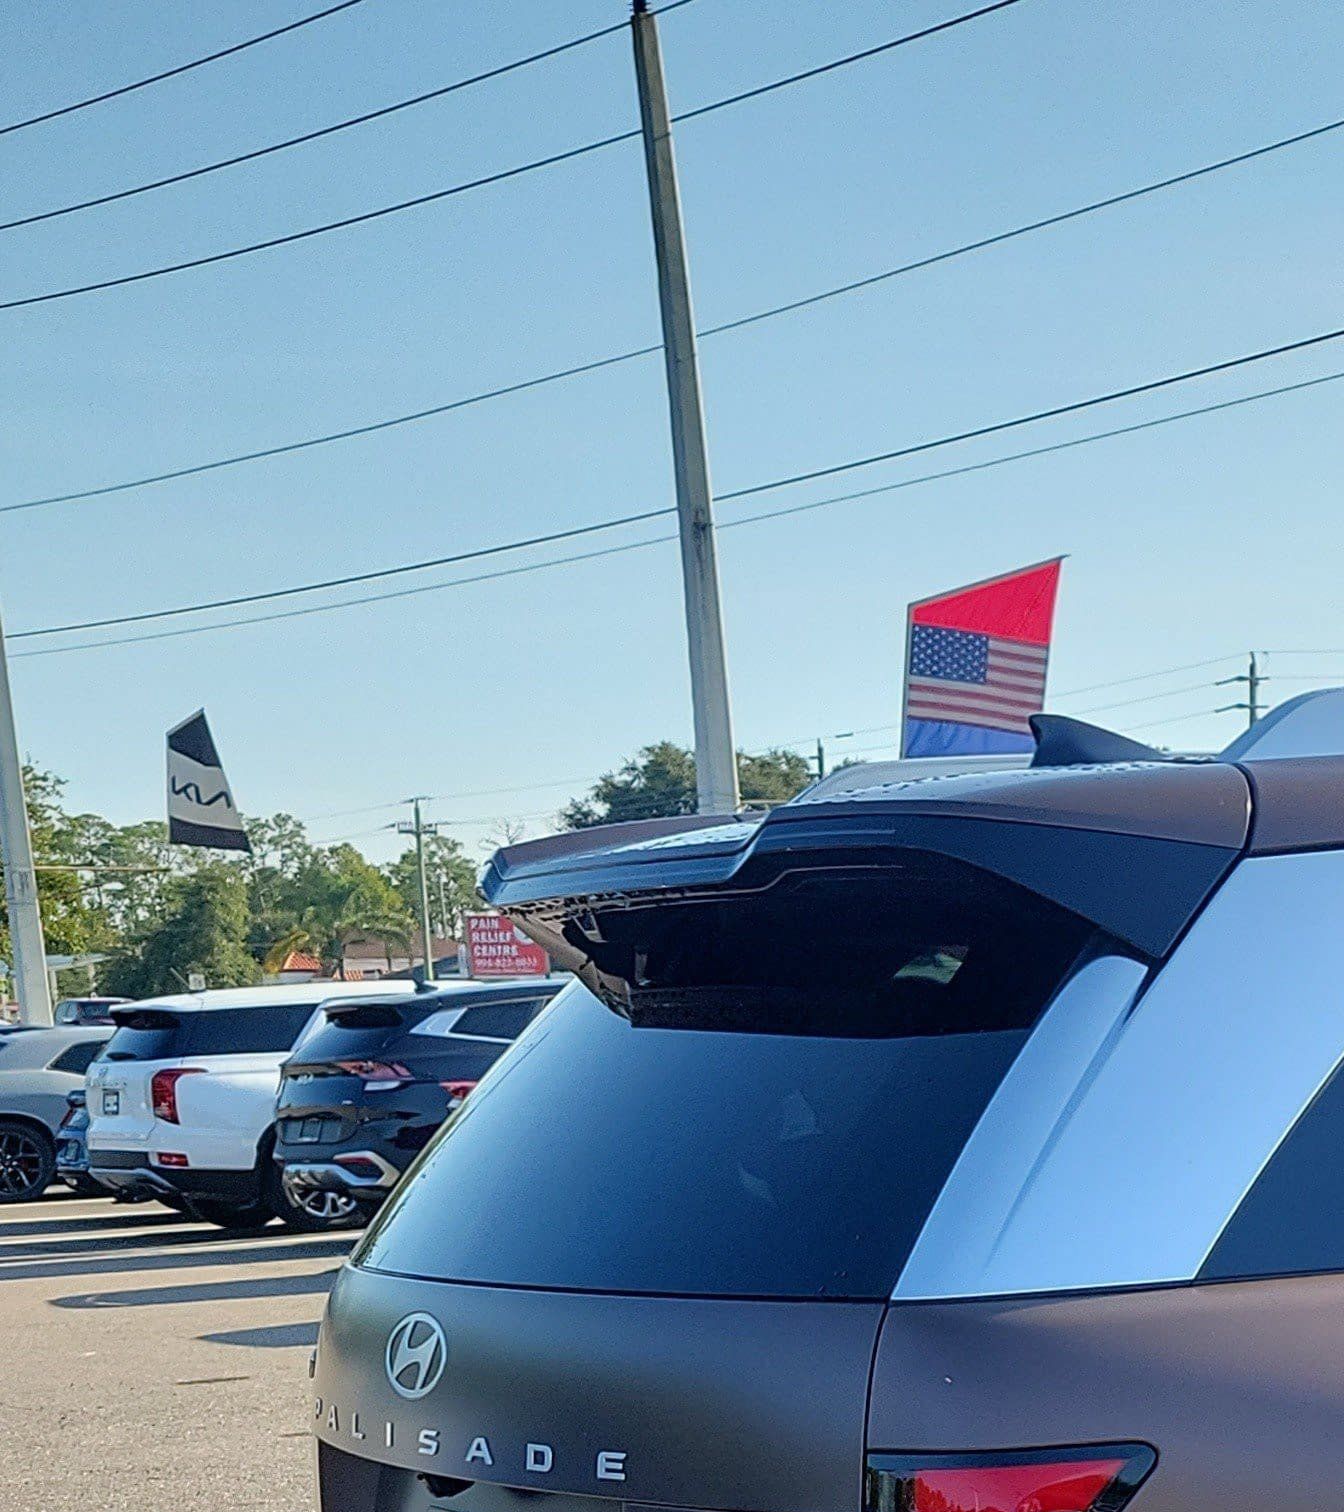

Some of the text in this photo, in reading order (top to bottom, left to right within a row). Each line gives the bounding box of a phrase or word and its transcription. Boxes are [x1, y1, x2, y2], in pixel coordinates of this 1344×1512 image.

[171, 775, 232, 809] KIA
[470, 917, 499, 930] PAIN
[471, 931, 512, 943] RELIEF
[473, 944, 518, 957] CENTRE
[315, 1397, 627, 1481] PALISADE
